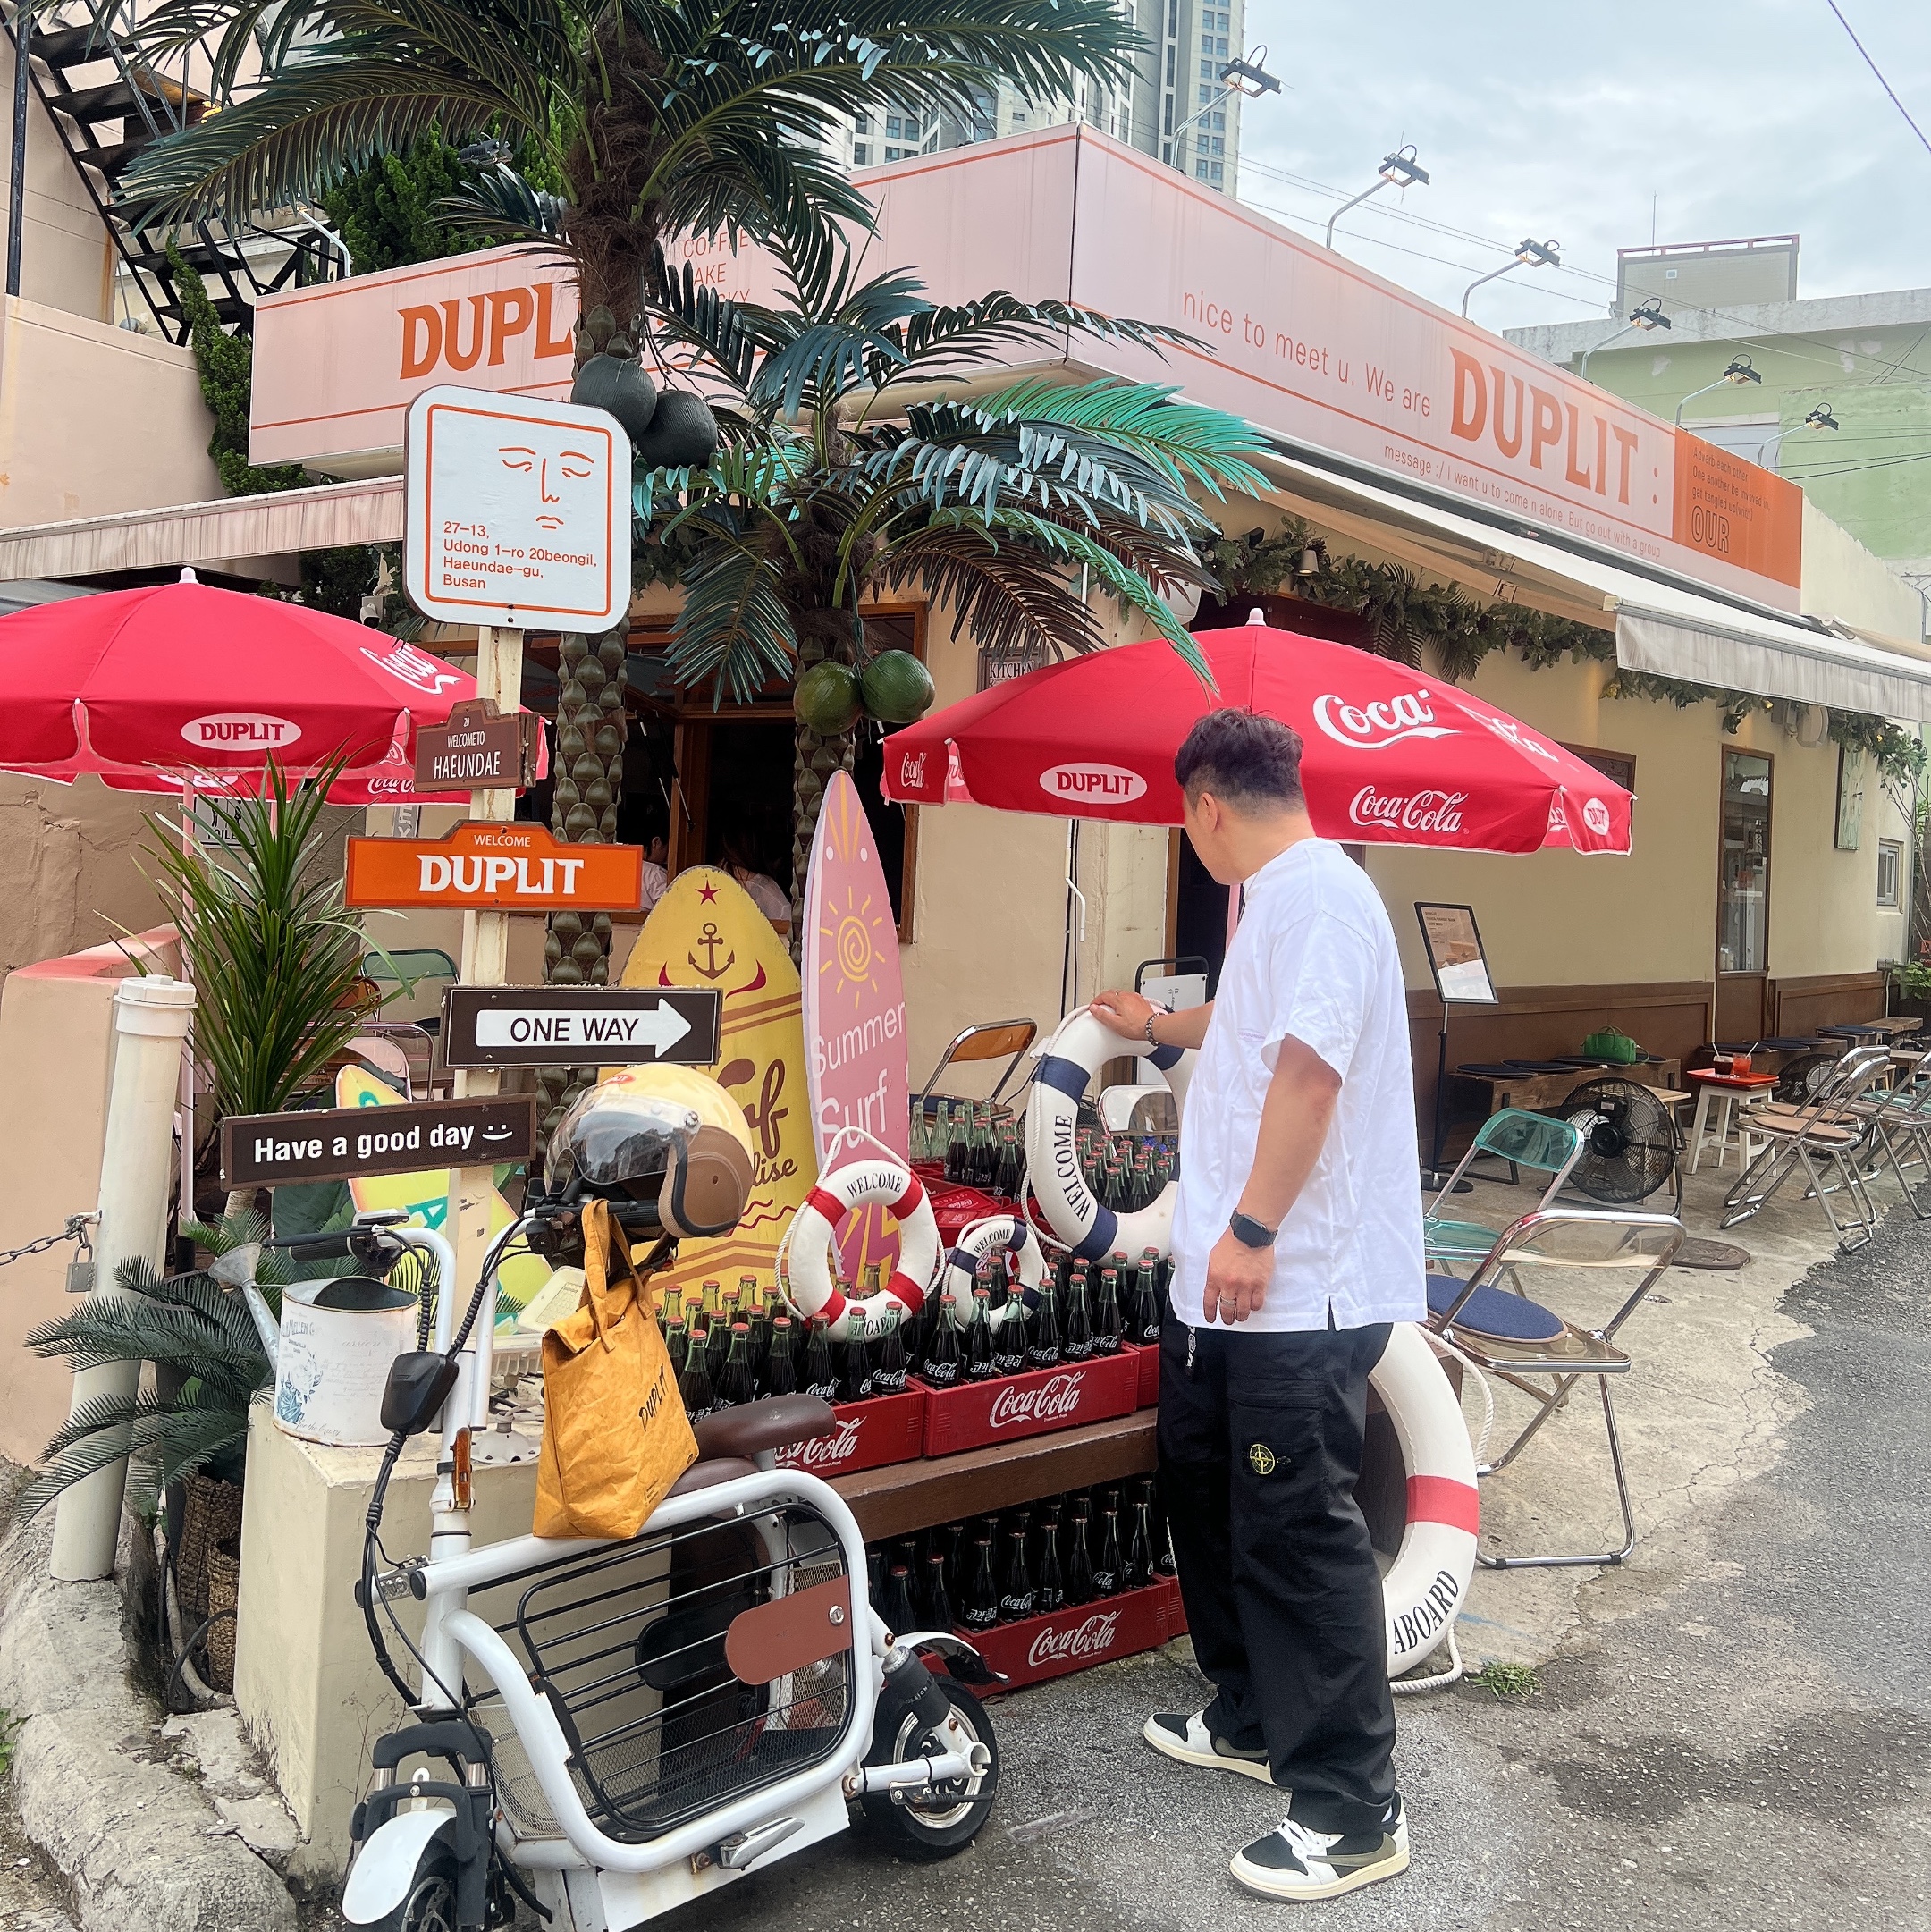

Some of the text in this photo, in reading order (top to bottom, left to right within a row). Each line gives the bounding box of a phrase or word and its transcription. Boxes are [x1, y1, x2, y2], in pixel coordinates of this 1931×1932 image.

[694, 262, 727, 287] AKE
[398, 282, 577, 380] DUPL
[1183, 290, 1431, 418] nice to meet u. We are
[1447, 345, 1639, 505] DUPLIT
[1384, 444, 1432, 477] message
[1455, 470, 1479, 492] want
[1481, 483, 1488, 494] u
[1491, 479, 1501, 499] to
[1504, 489, 1537, 512] come'n
[1568, 510, 1583, 529] But
[1585, 520, 1596, 538] go
[1598, 526, 1611, 540] out
[1613, 530, 1631, 548] with
[1632, 537, 1638, 548] a
[1640, 540, 1661, 560] group
[1691, 505, 1730, 554] OUR
[443, 538, 489, 556] Udong
[529, 547, 597, 568] 20beongil,
[443, 556, 544, 578] Haeundae-gu,
[443, 573, 486, 589] Busan
[198, 722, 286, 741] DUPLIT
[447, 730, 485, 748] WELCOME TO
[433, 751, 502, 780] HAEUNDAE
[1055, 771, 1134, 796] DUPLIT
[1348, 784, 1470, 834] Coca-Cola
[474, 834, 531, 848] WELCOME
[416, 854, 585, 895] DUPLIT
[510, 1017, 640, 1042] ONE WAY
[811, 1001, 906, 1080] Summer
[818, 1068, 889, 1159] Surf
[254, 1123, 475, 1163] Have a good day
[847, 1173, 903, 1199] WELCOME
[1054, 1114, 1092, 1223] WELCOME
[974, 1228, 1011, 1255] WELCOME
[638, 1363, 668, 1432] DUPLIT
[989, 1371, 1087, 1428] Coca-Cola
[1392, 1569, 1459, 1655] ABOARD
[1028, 1608, 1124, 1666] Coca-Cola
